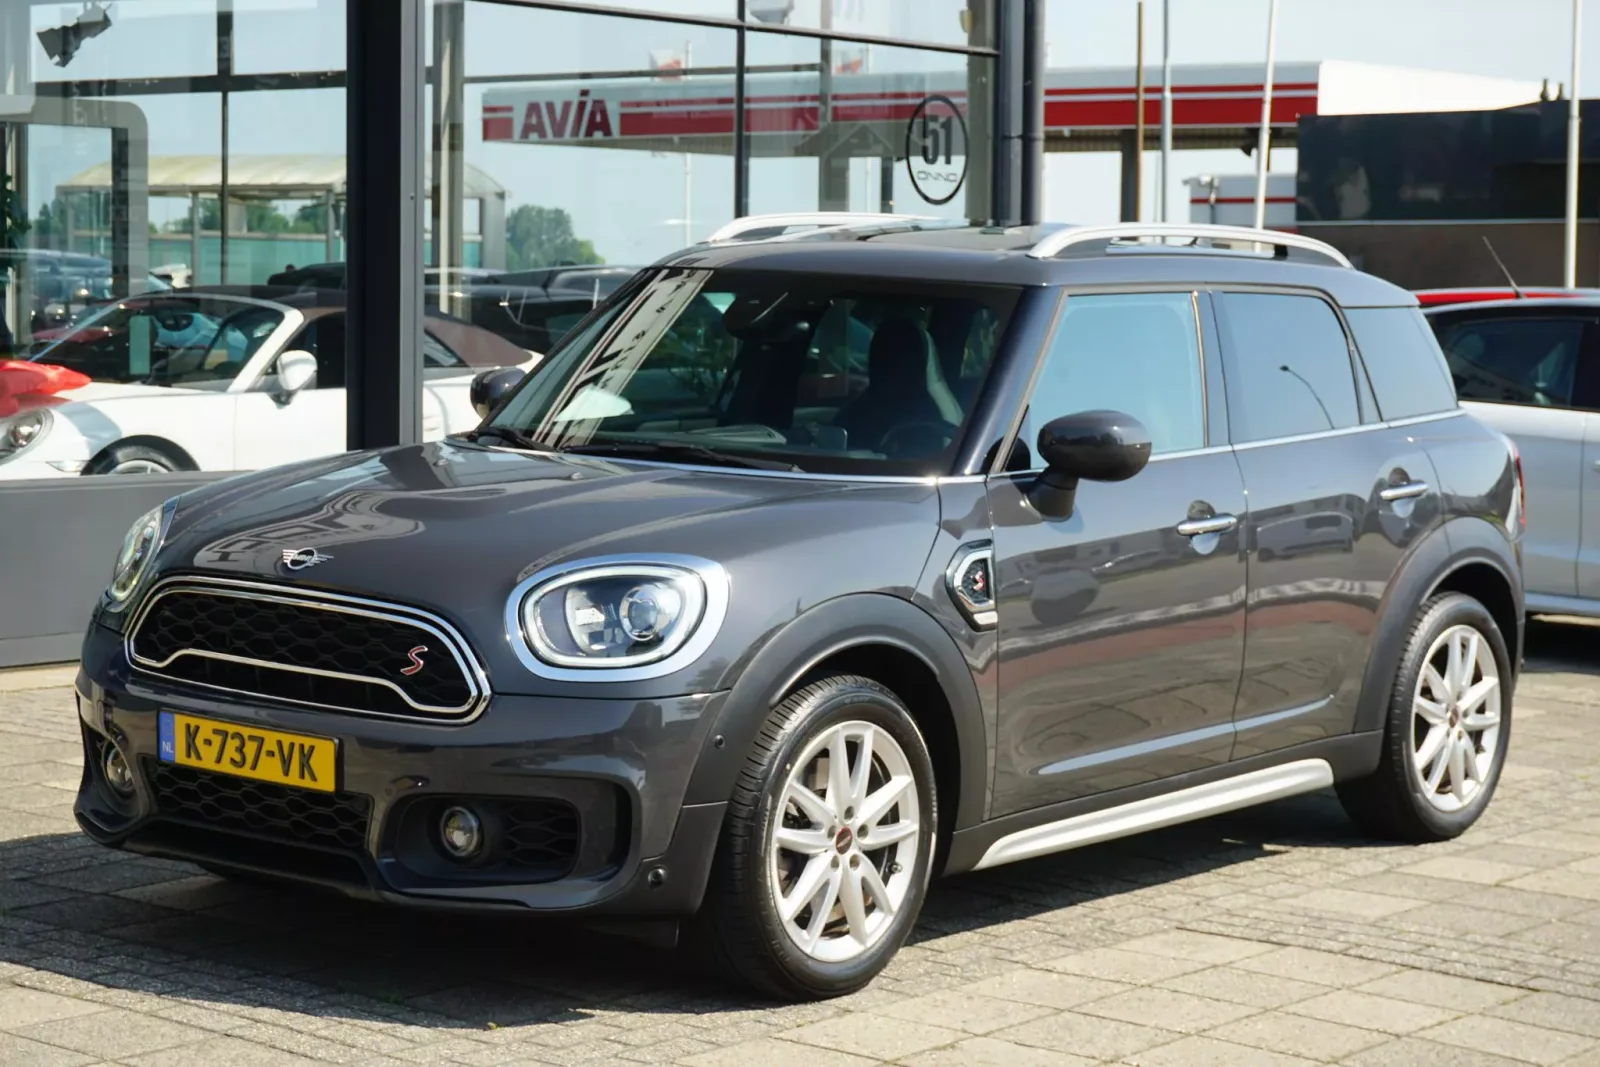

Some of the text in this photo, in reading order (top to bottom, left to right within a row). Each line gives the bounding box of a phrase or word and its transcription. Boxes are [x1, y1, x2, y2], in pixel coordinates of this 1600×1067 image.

[922, 114, 953, 165] 51
[400, 645, 428, 676] S
[162, 741, 174, 754] NL
[184, 722, 318, 782] K-737-VK
